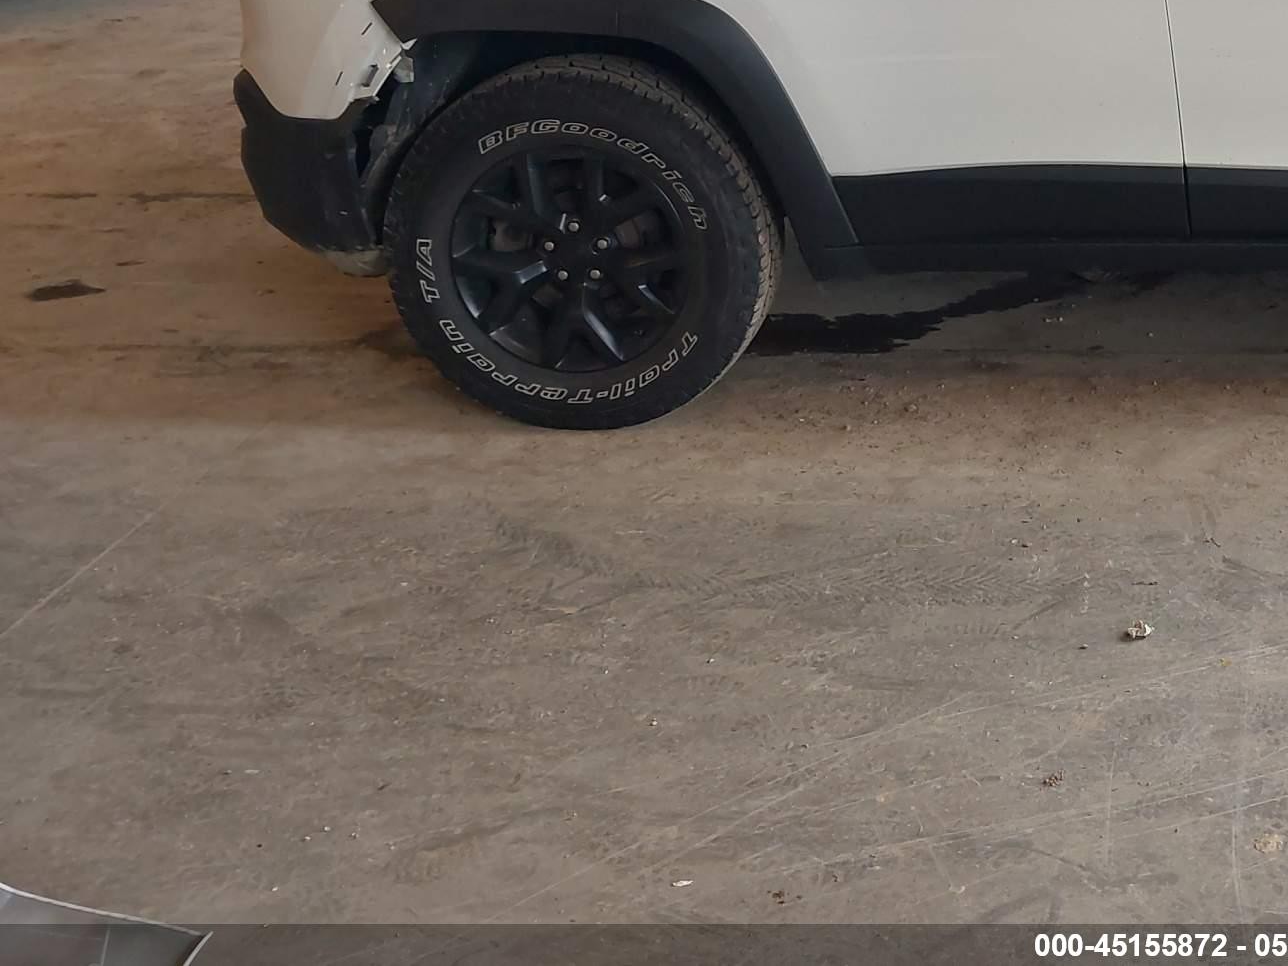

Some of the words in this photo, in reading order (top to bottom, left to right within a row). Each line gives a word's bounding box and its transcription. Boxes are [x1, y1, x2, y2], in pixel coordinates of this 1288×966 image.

[478, 119, 708, 230] BFGoodrich
[416, 238, 440, 303] T/A
[439, 319, 699, 404] Trail-Terrain
